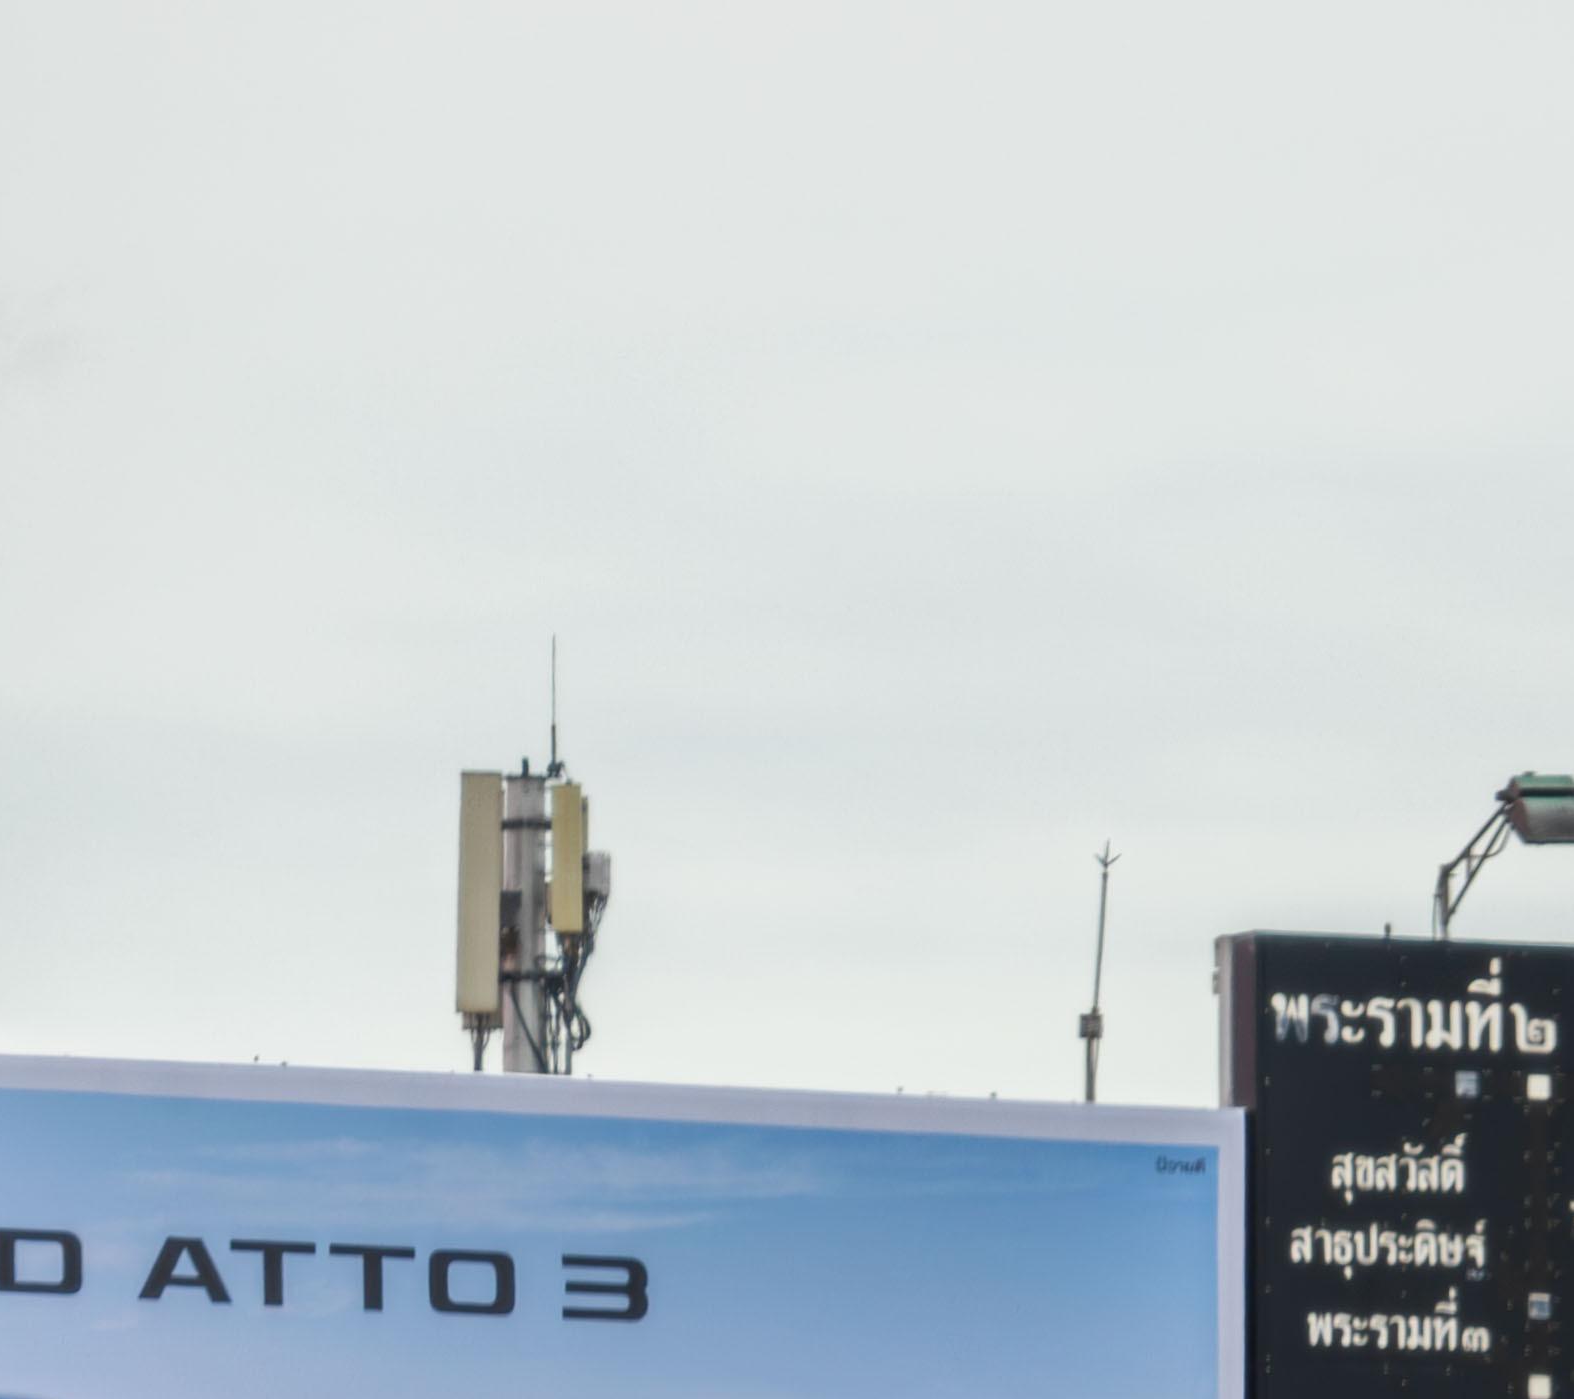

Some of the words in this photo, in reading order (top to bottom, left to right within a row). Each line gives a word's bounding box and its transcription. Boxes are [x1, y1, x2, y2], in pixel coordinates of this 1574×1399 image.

[1332, 1133, 1467, 1204] สุขสวัสดิ์
[138, 1237, 516, 1316] ATTO
[561, 1254, 649, 1322] 3
